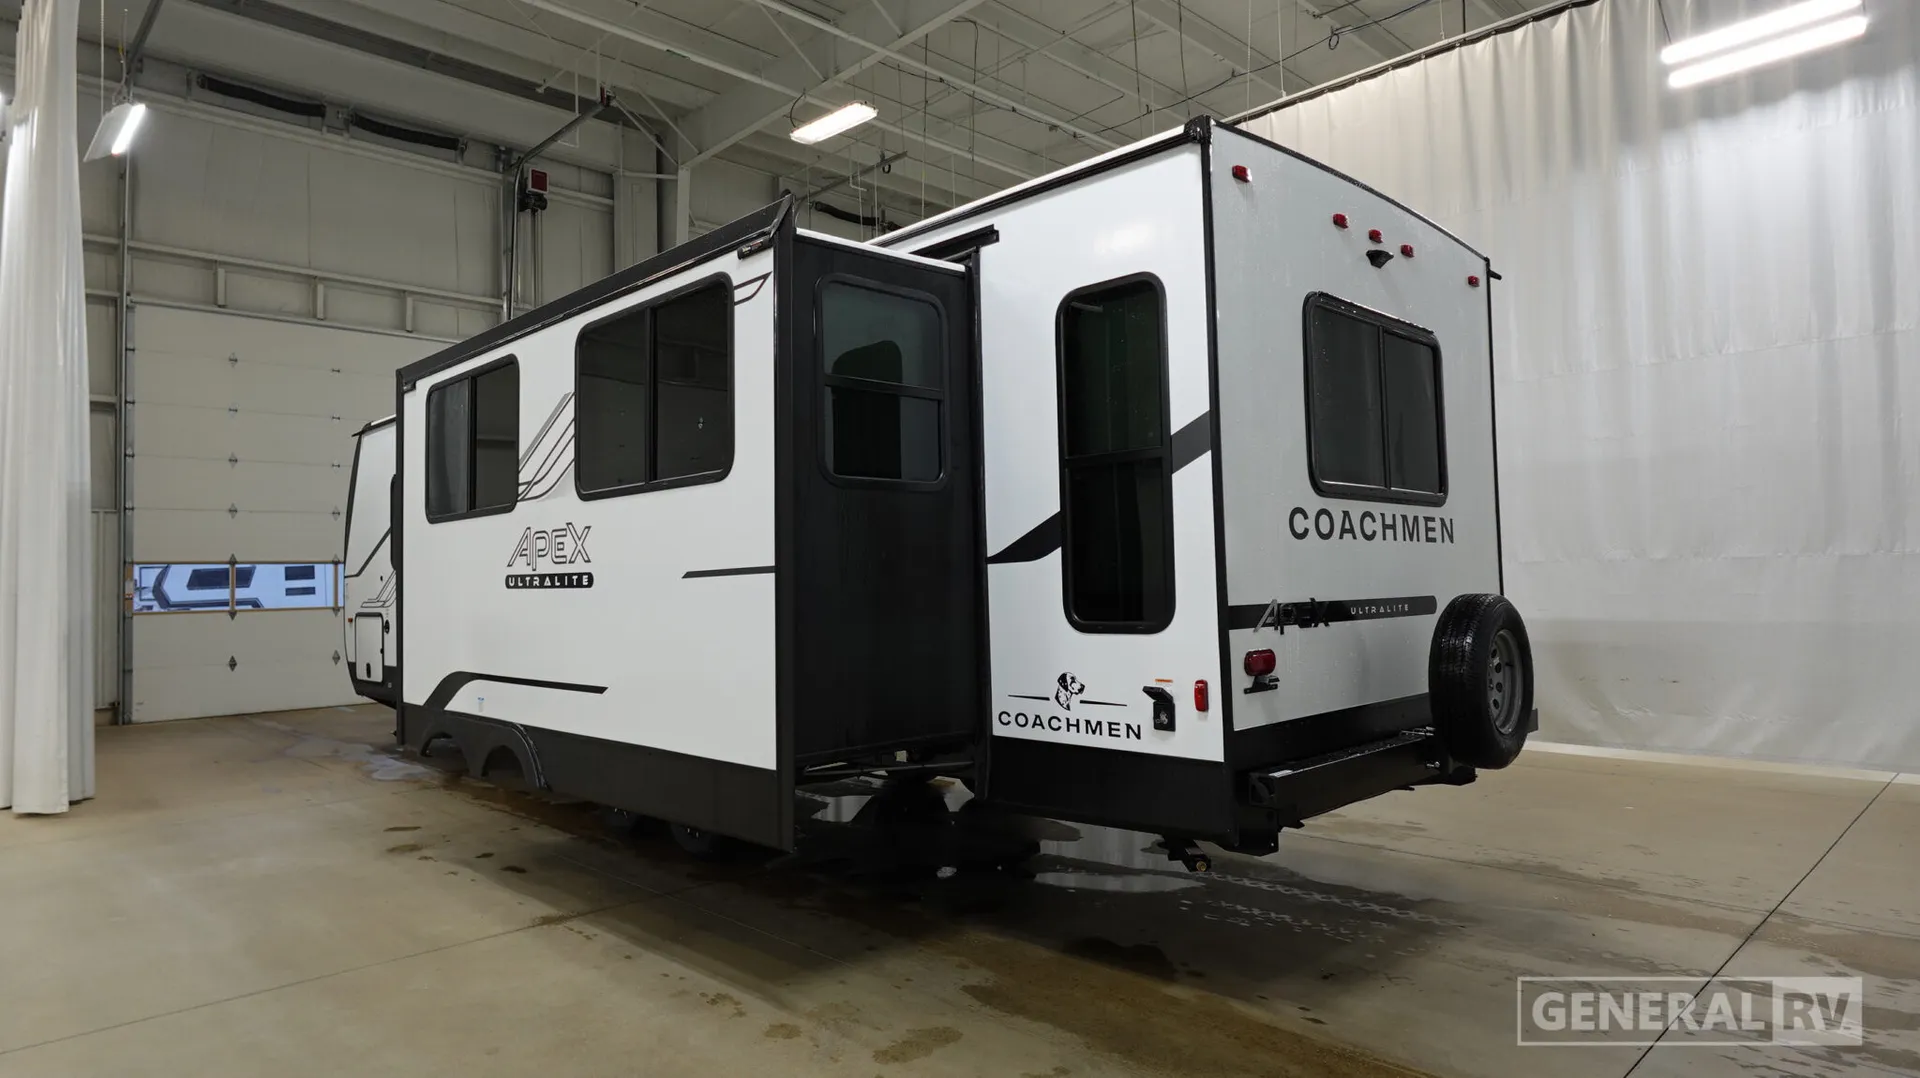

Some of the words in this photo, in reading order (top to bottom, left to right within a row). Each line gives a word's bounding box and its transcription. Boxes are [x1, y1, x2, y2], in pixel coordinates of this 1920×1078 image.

[1288, 506, 1455, 544] COACHMEN
[507, 522, 592, 571] APEX
[508, 575, 590, 587] ULTRALITE
[1350, 603, 1410, 615] ULTRALITE
[998, 710, 1142, 740] COACHMEN
